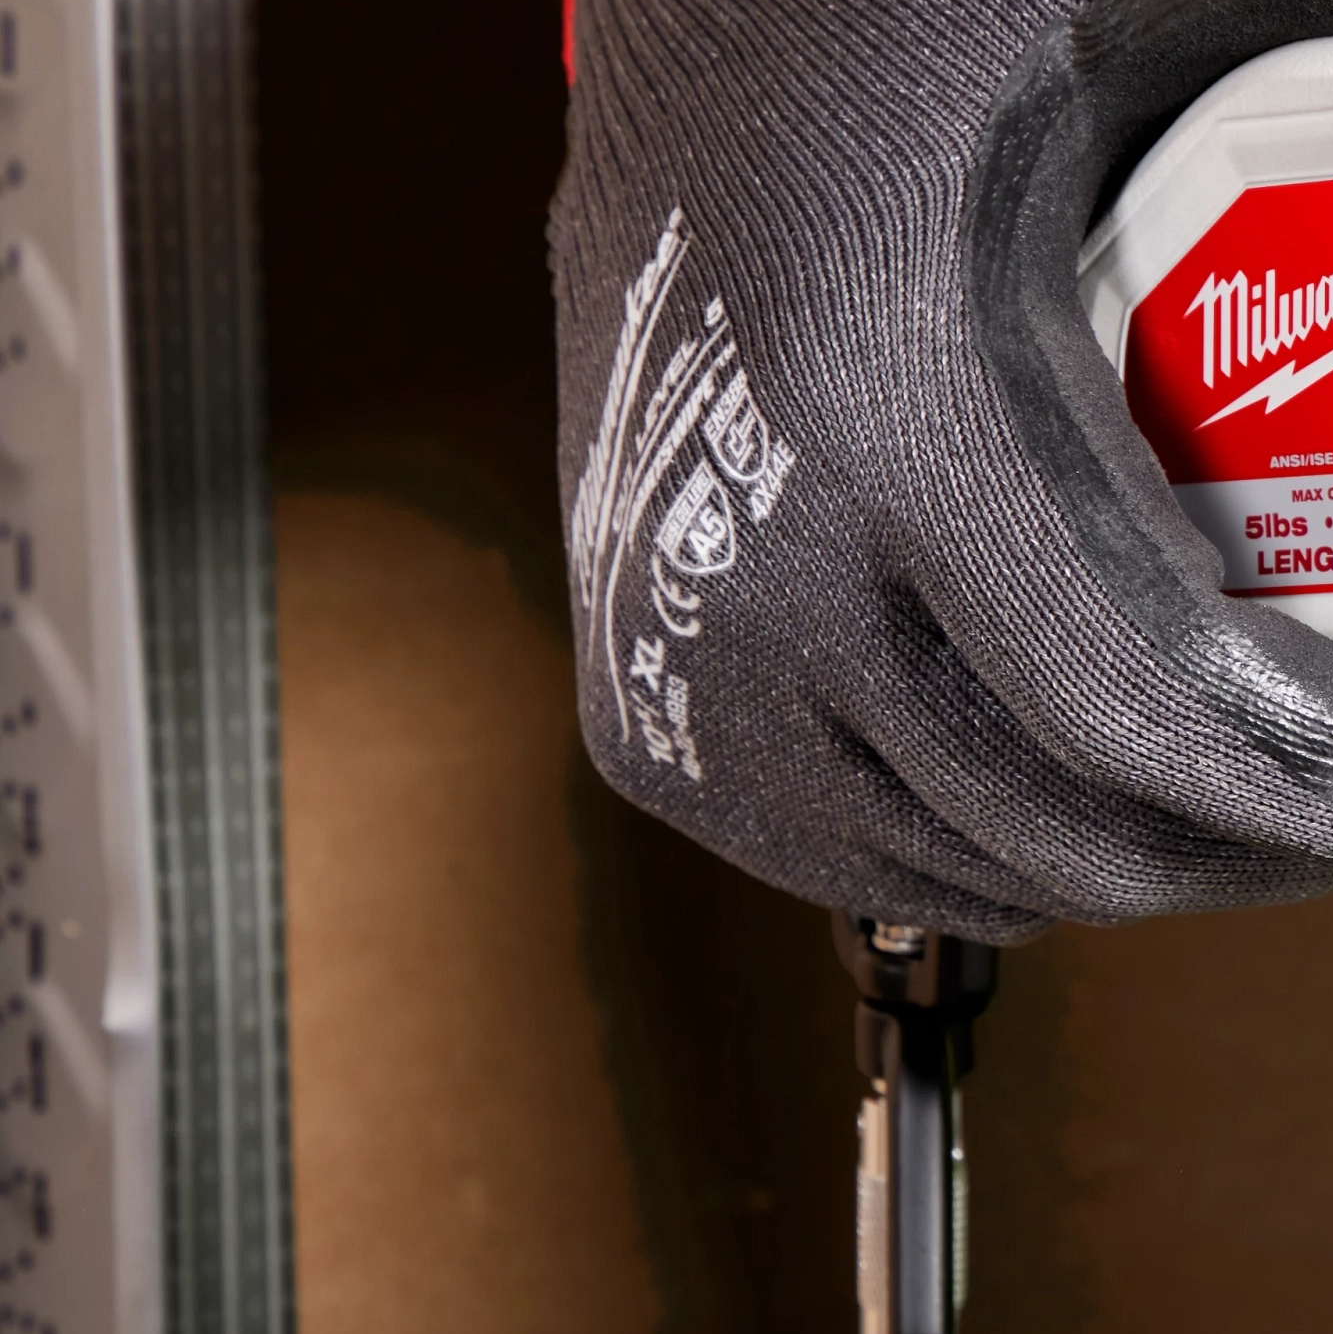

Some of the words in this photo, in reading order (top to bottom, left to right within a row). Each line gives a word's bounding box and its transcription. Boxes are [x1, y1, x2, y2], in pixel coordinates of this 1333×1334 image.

[635, 337, 699, 454] LEVEL
[704, 296, 724, 327] 5
[703, 369, 748, 438] EN388
[749, 437, 797, 521] 4X44E
[1291, 487, 1324, 503] MAX
[687, 506, 728, 566] A5
[1245, 512, 1308, 540] 5lbs
[630, 635, 665, 692] XL
